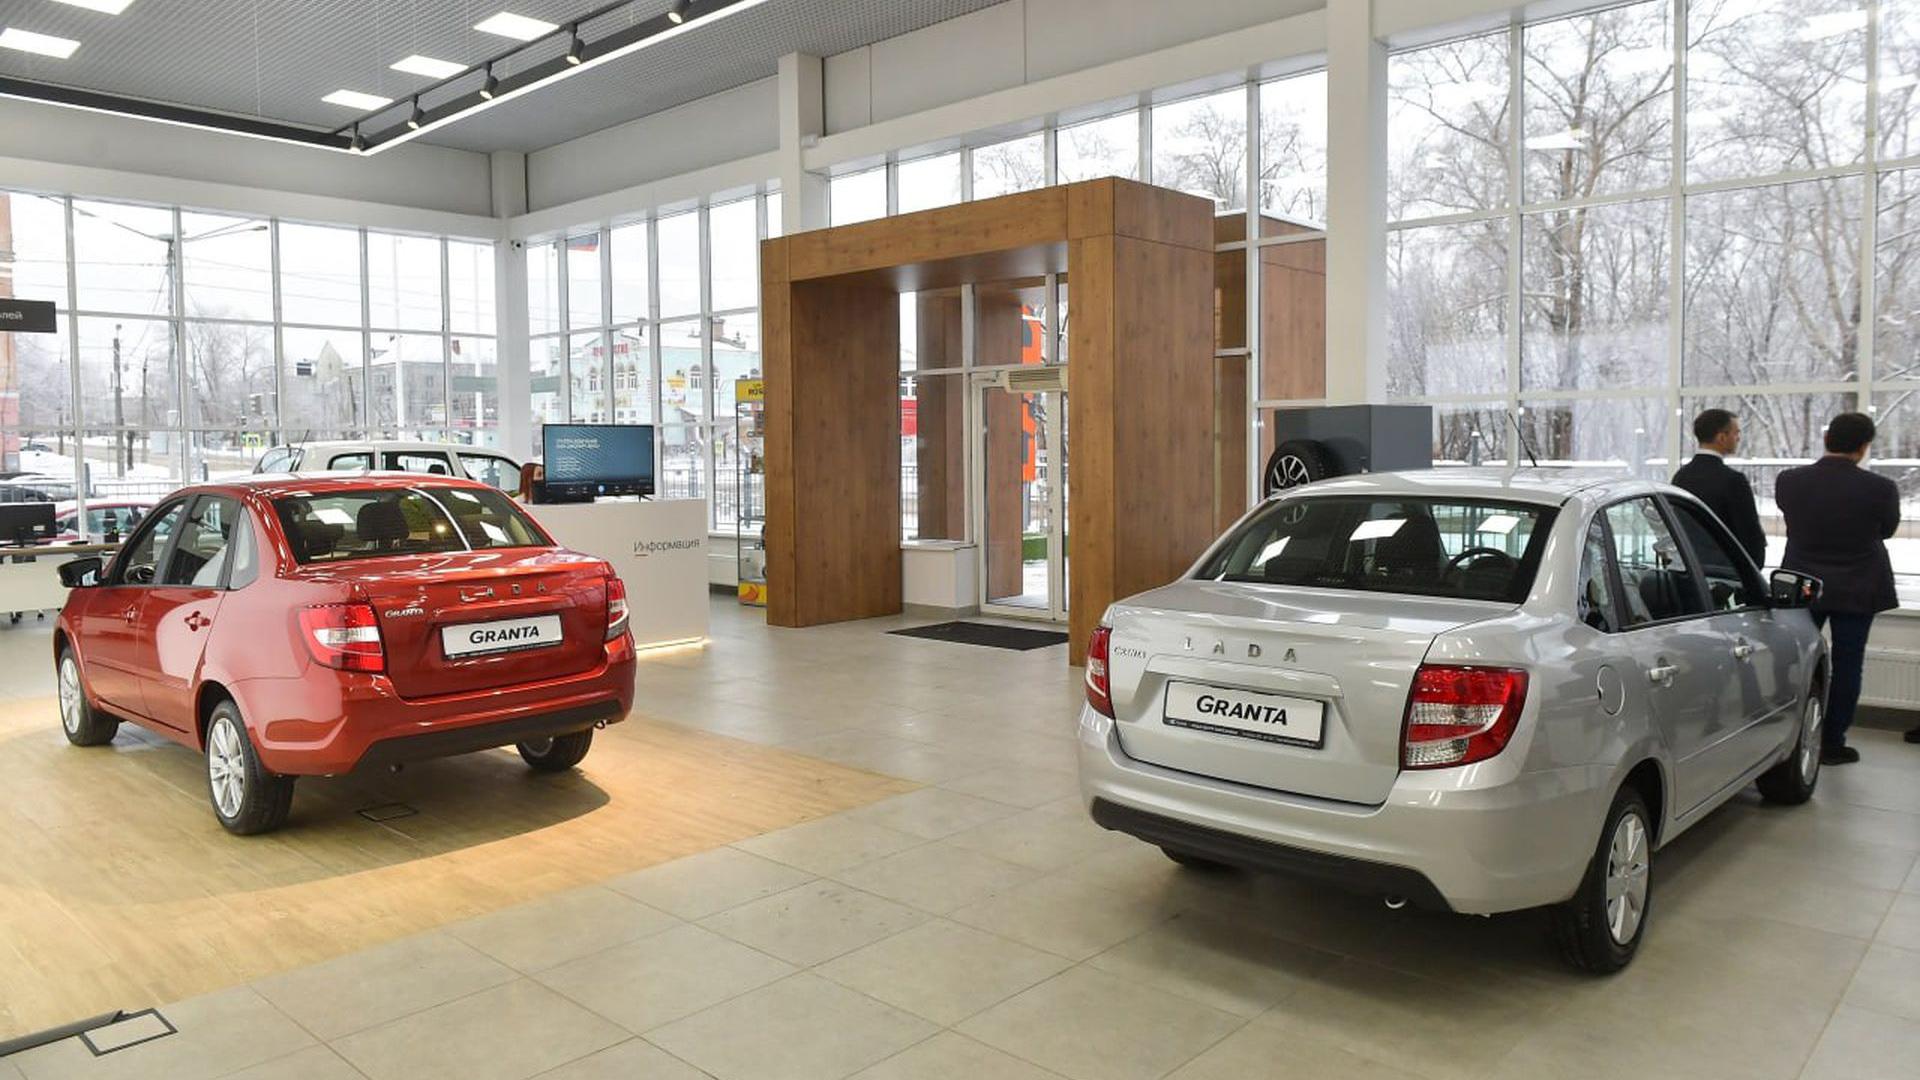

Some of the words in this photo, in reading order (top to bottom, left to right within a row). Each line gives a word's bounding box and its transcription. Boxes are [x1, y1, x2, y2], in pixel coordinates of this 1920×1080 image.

[0, 311, 24, 321] лей
[633, 538, 701, 554] Информация
[460, 584, 546, 603] LADA
[469, 626, 540, 645] GRANTA
[1184, 635, 1297, 662] LADA
[1196, 695, 1288, 726] GRANTA
